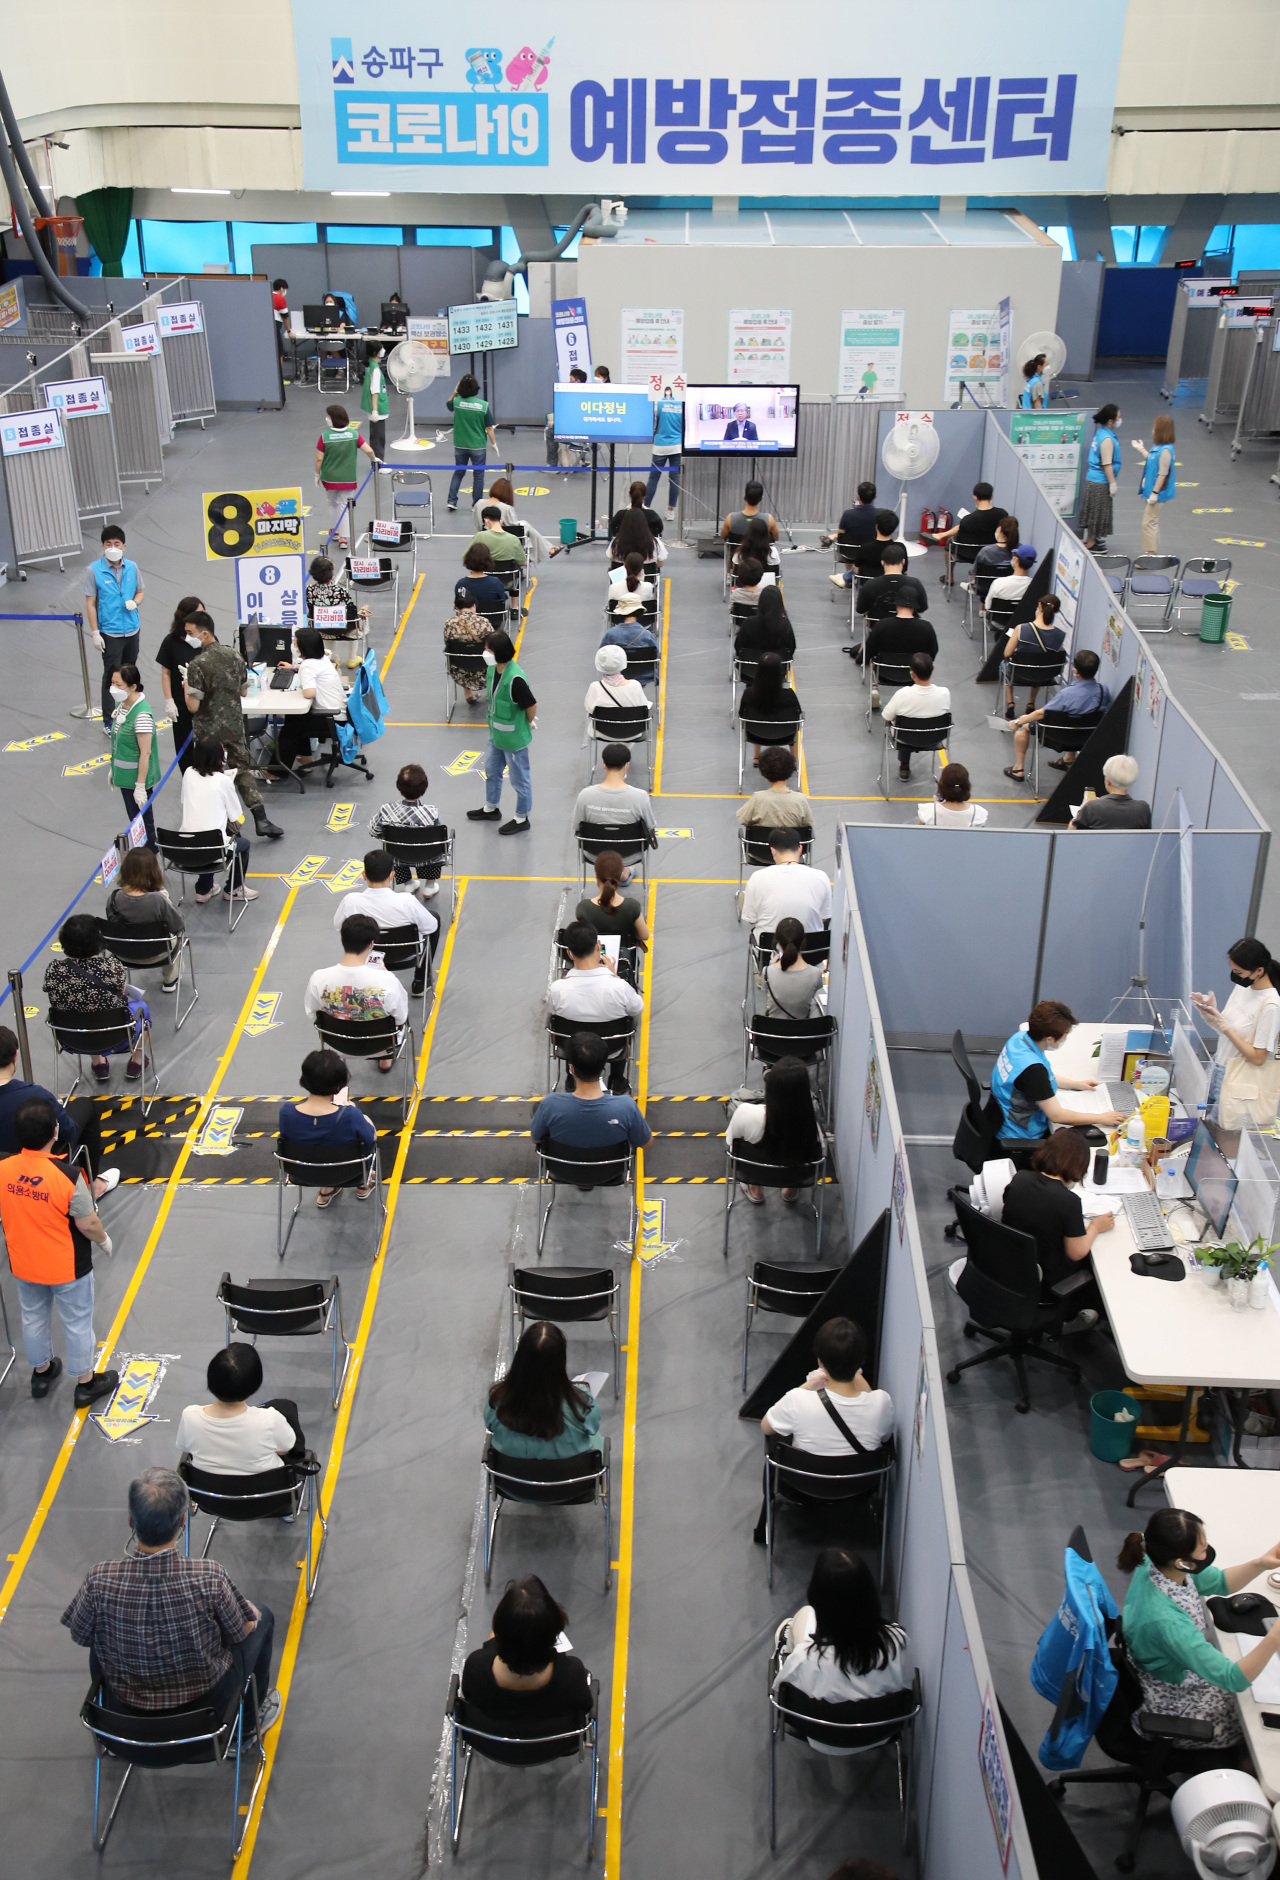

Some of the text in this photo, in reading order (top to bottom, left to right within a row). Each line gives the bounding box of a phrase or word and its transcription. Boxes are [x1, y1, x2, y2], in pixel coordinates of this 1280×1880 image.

[361, 45, 444, 79] 송파구
[570, 74, 1078, 165] 예방접종센터
[347, 102, 539, 156] 코로나19
[171, 312, 196, 325] 접종실
[453, 321, 513, 334] 1433 1432 1431
[453, 338, 514, 351] 1430 1429 1428
[66, 391, 99, 405] 접종실
[581, 401, 626, 415] 이다정님
[18, 422, 54, 438] 접종실
[207, 493, 255, 557] 8
[257, 519, 298, 534] 마지막
[7, 1183, 49, 1203] 의용소방대
